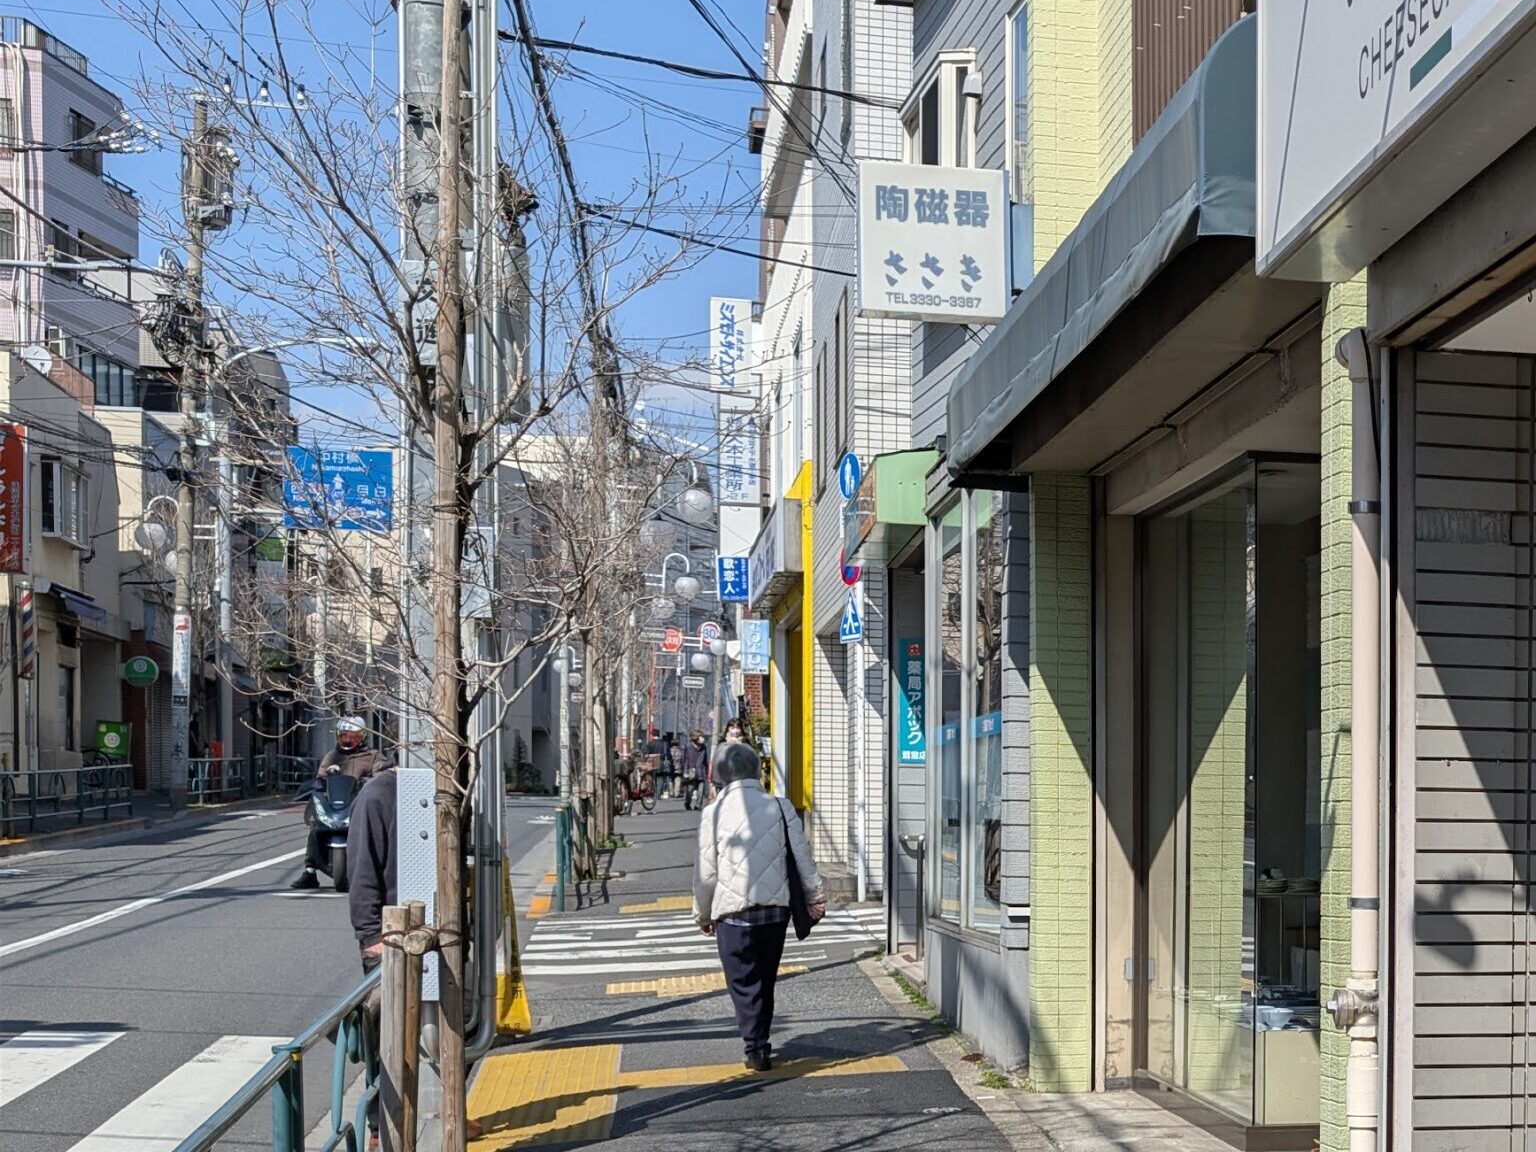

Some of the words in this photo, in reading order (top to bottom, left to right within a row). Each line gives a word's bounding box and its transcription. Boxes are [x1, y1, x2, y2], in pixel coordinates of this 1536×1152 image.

[875, 185, 989, 228] 陶磁器
[883, 250, 983, 293] ささき
[703, 629, 716, 639] 30
